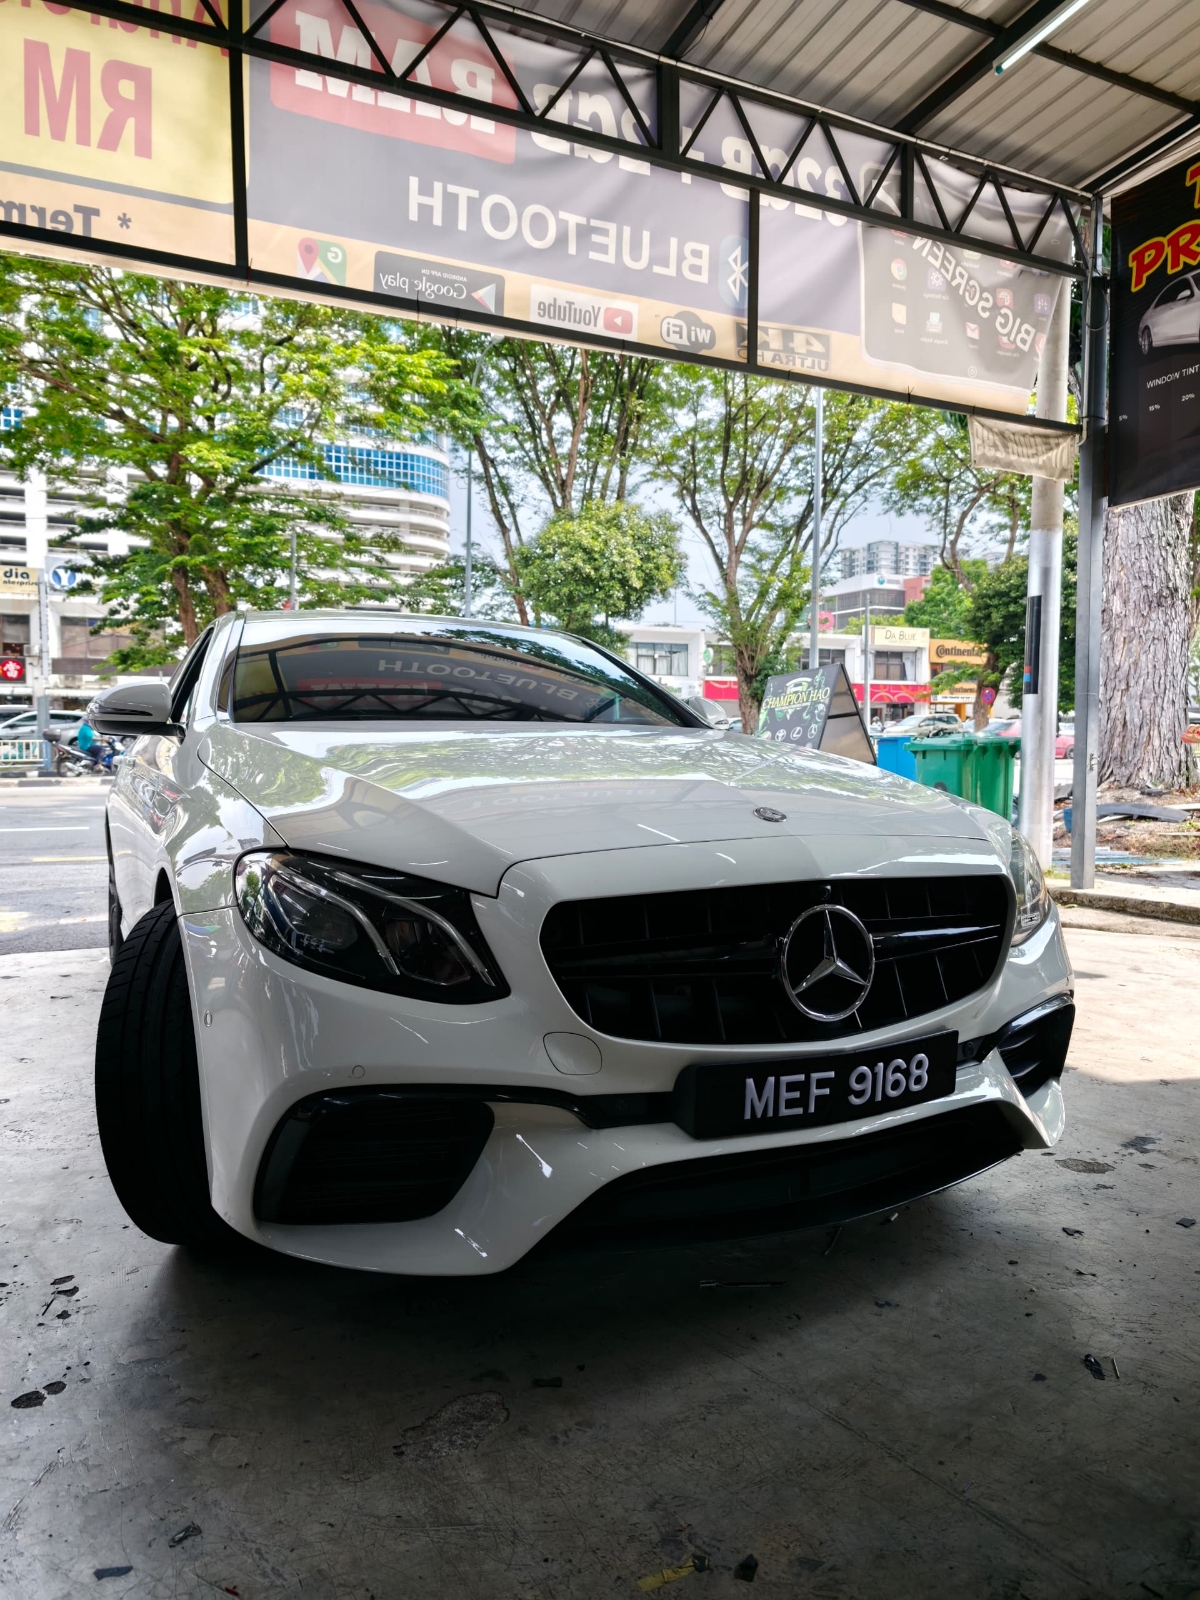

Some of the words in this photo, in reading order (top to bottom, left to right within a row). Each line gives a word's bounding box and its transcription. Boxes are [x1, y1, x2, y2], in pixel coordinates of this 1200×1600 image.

[1146, 371, 1180, 389] WINDOW
[1181, 364, 1200, 377] TINT
[3, 567, 30, 580] dia
[762, 691, 808, 709] CHAMPION
[809, 687, 830, 702] HAO
[744, 1070, 835, 1120] MEF
[848, 1053, 929, 1106] 9168
